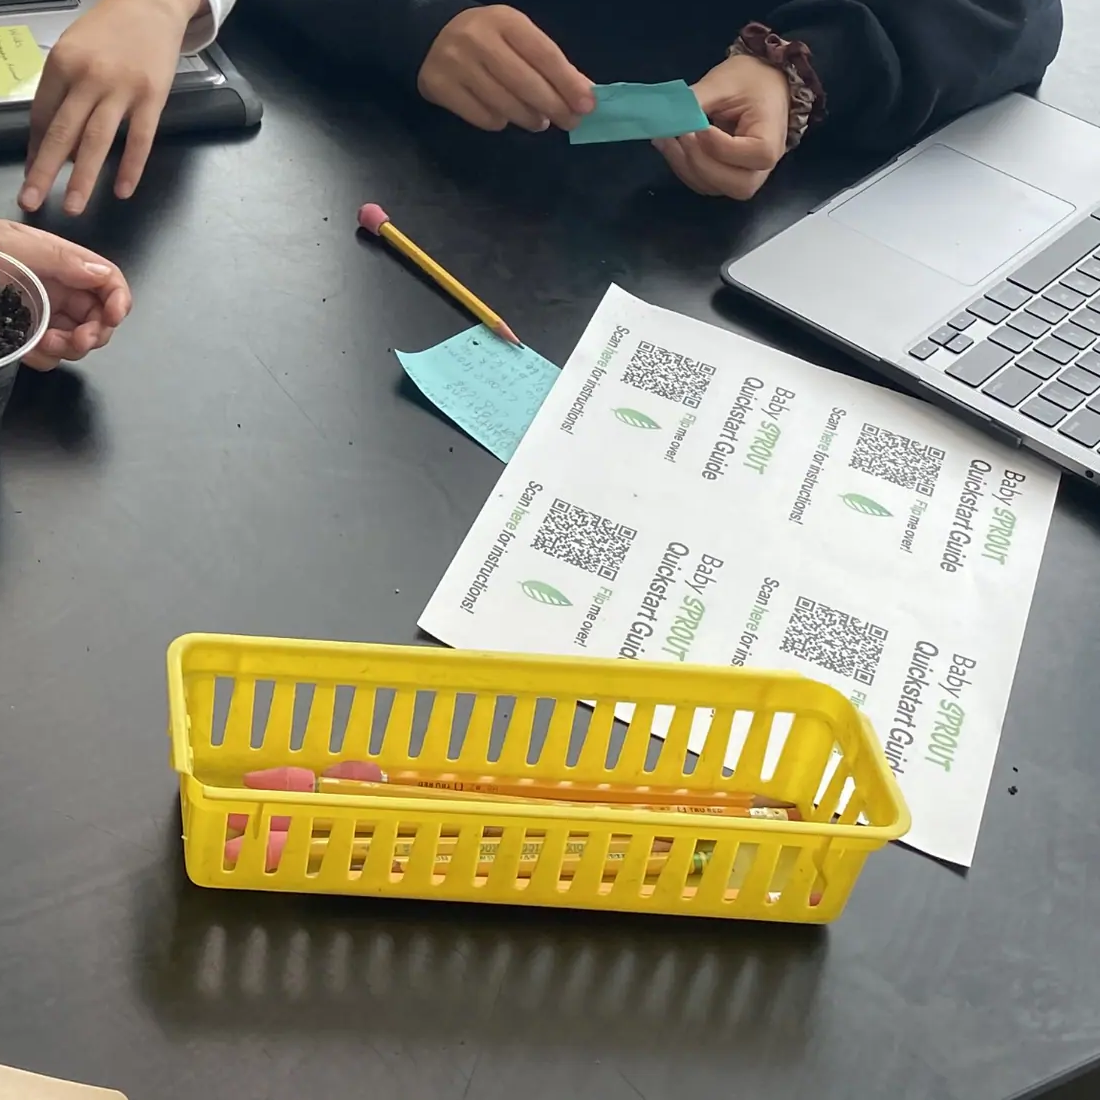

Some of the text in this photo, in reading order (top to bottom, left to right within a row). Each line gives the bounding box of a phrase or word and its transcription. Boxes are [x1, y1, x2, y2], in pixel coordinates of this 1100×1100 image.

[560, 325, 630, 435] Scan here for instructions!
[702, 377, 764, 480] Quickstart Guide
[743, 387, 796, 475] Baby SPROUT
[664, 412, 697, 463] Flip me over!
[788, 407, 847, 525] Scan here for instructions!
[459, 480, 544, 614] Scan here for instructions!
[900, 499, 928, 554] Flip me over!
[940, 459, 992, 573] Quickstart Guide
[981, 469, 1026, 565] Baby SPROUT
[574, 586, 613, 648] Flip me over!
[617, 542, 690, 660] Quickstart Guid
[661, 553, 724, 662] Baby SPROUT
[738, 630, 758, 650] for
[746, 603, 770, 631] here
[756, 577, 780, 606] Scan
[884, 640, 939, 778] Quickstart Guid
[924, 653, 977, 772] Baby SPROUT
